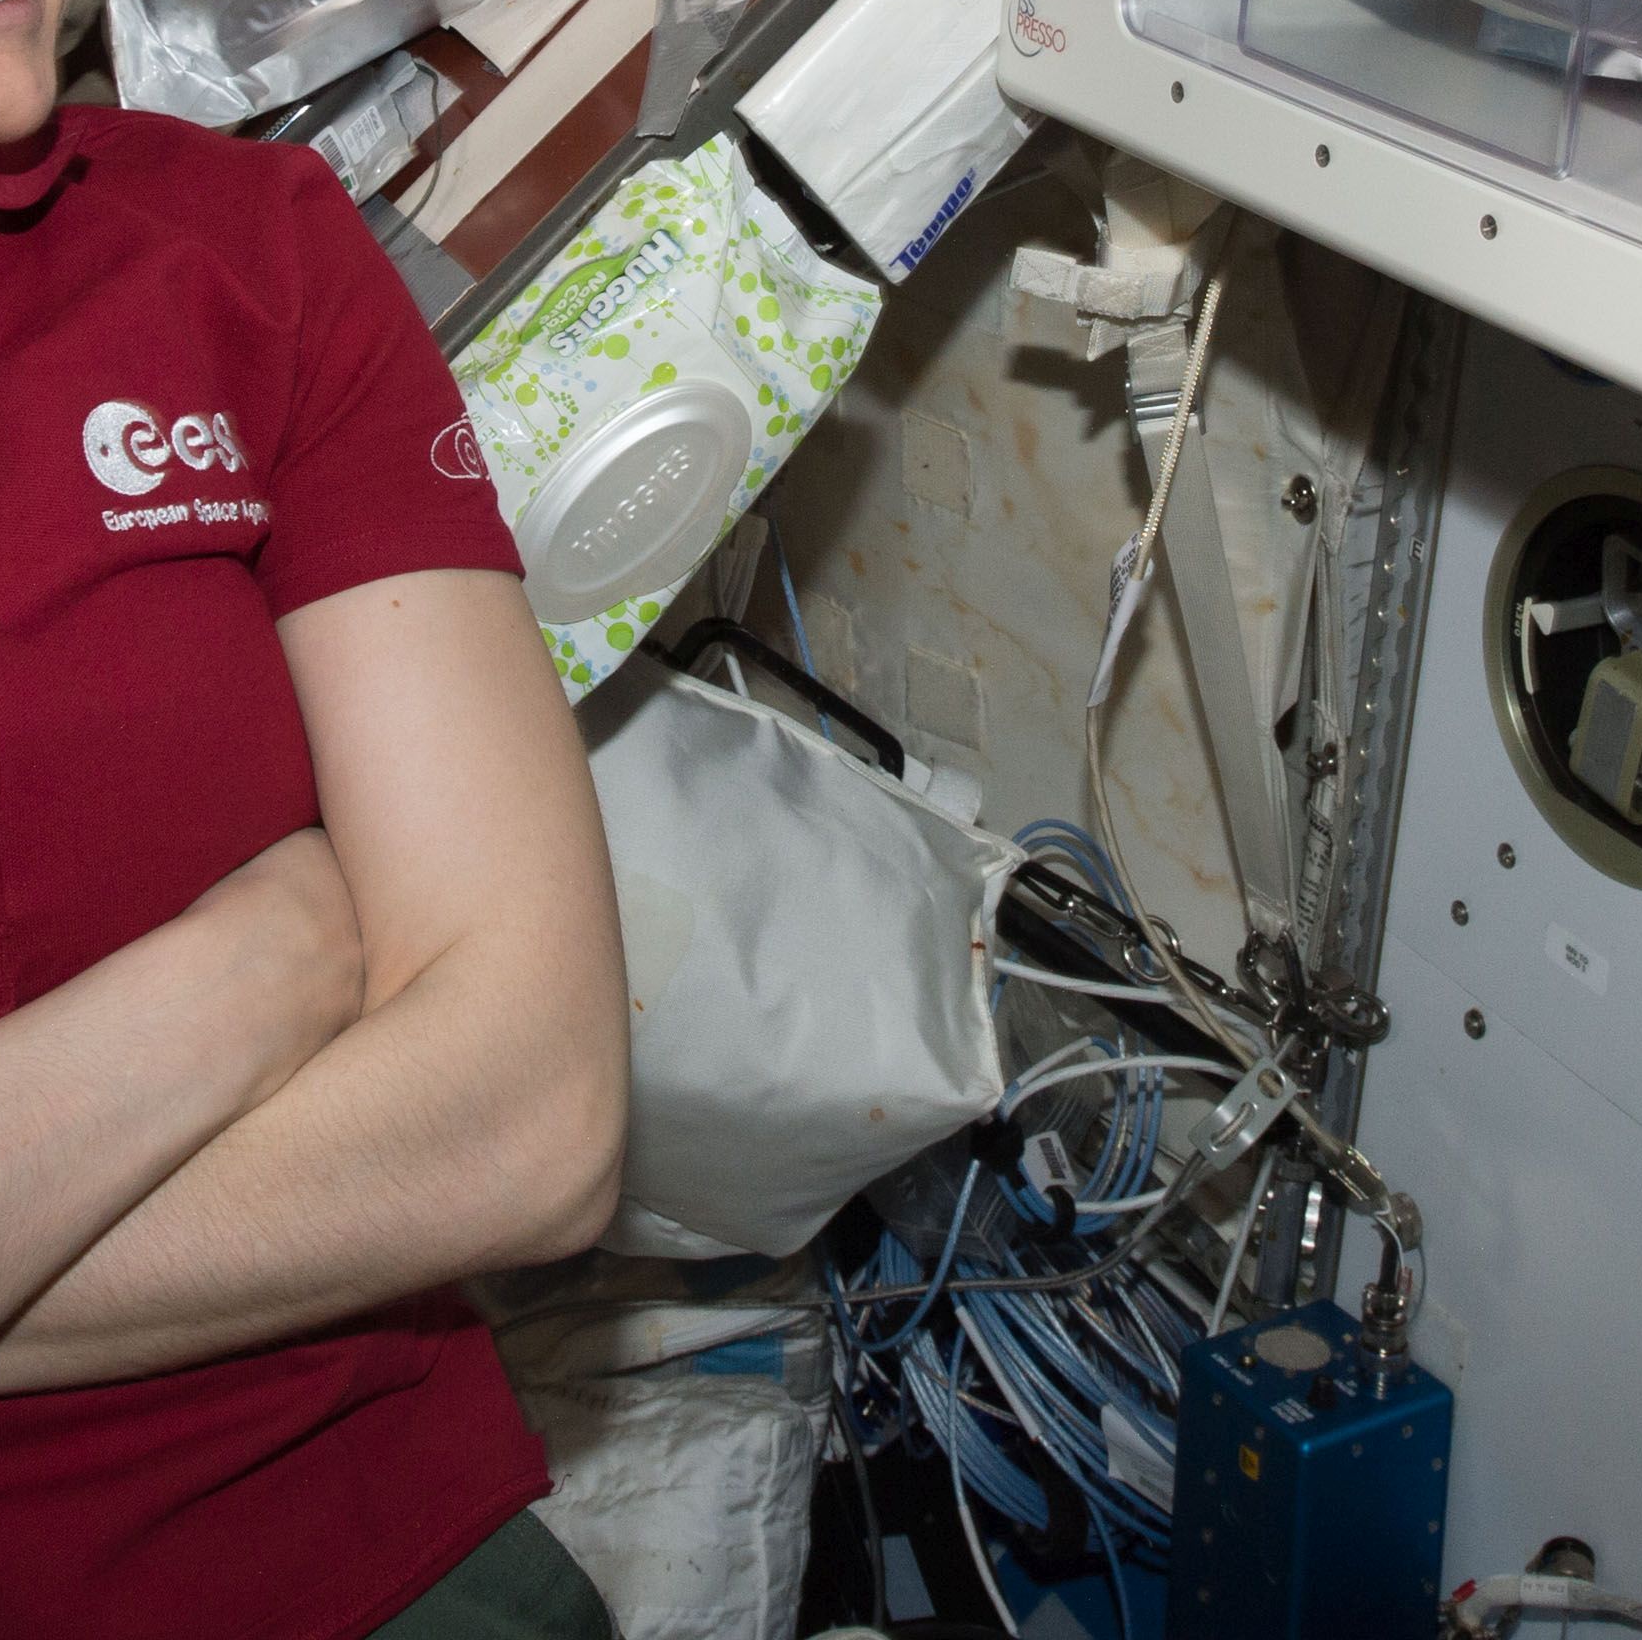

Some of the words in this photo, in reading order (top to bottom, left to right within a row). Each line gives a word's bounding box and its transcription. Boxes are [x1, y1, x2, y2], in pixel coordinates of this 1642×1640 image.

[1015, 12, 1067, 53] PRESSO
[889, 172, 975, 273] Tempo
[539, 283, 581, 326] Care
[541, 270, 608, 334] Natural
[549, 228, 686, 358] HUGGIES
[101, 504, 190, 532] European
[192, 498, 240, 526] Space
[1514, 602, 1525, 638] OPEN
